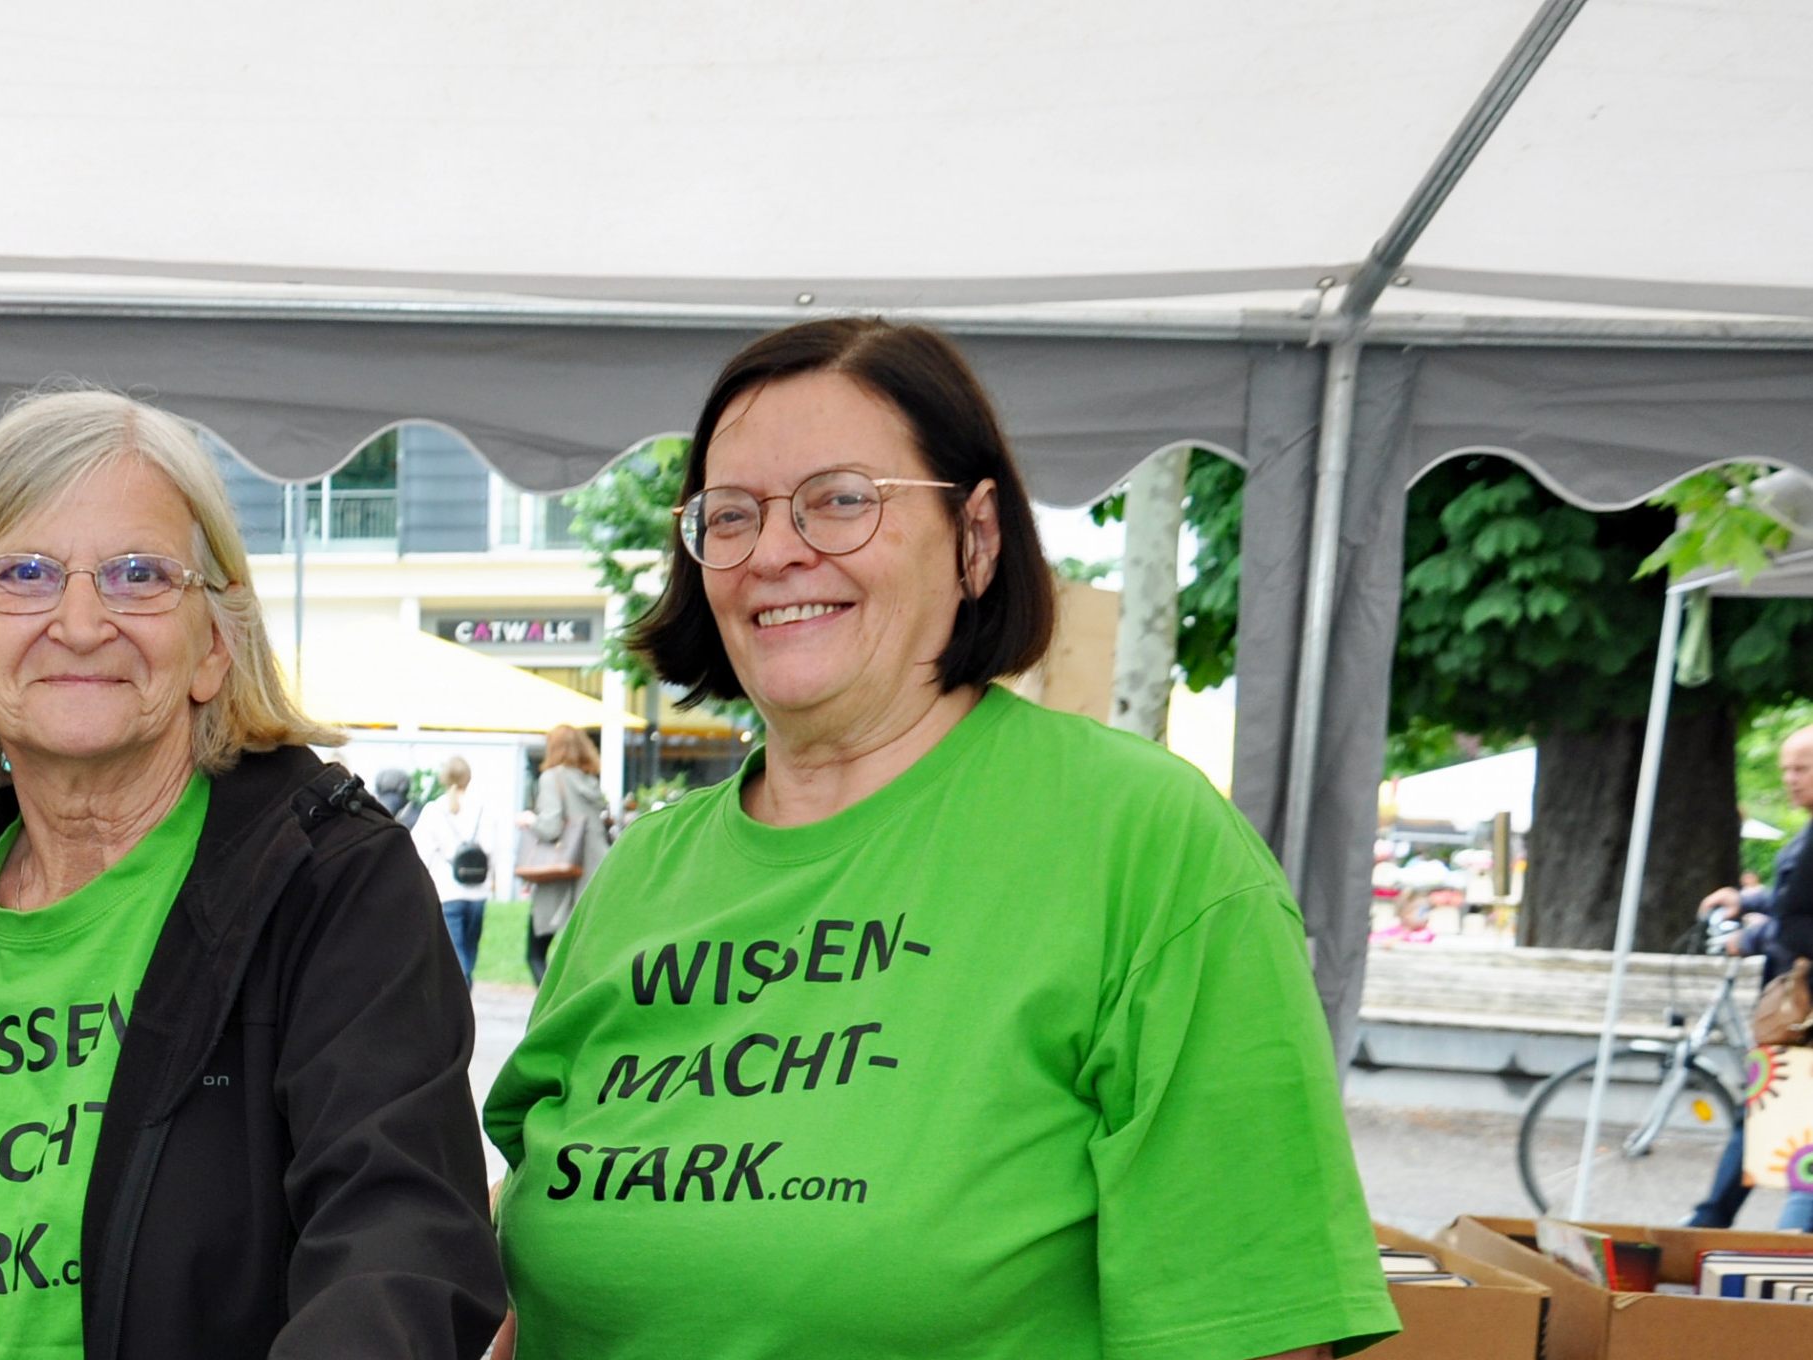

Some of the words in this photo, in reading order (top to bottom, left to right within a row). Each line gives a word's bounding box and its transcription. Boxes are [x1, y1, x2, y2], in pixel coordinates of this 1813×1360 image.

[455, 621, 575, 643] CATWALK
[203, 1076, 229, 1086] on
[597, 1023, 898, 1104] MACHT-
[548, 1142, 867, 1203] STARK.com
